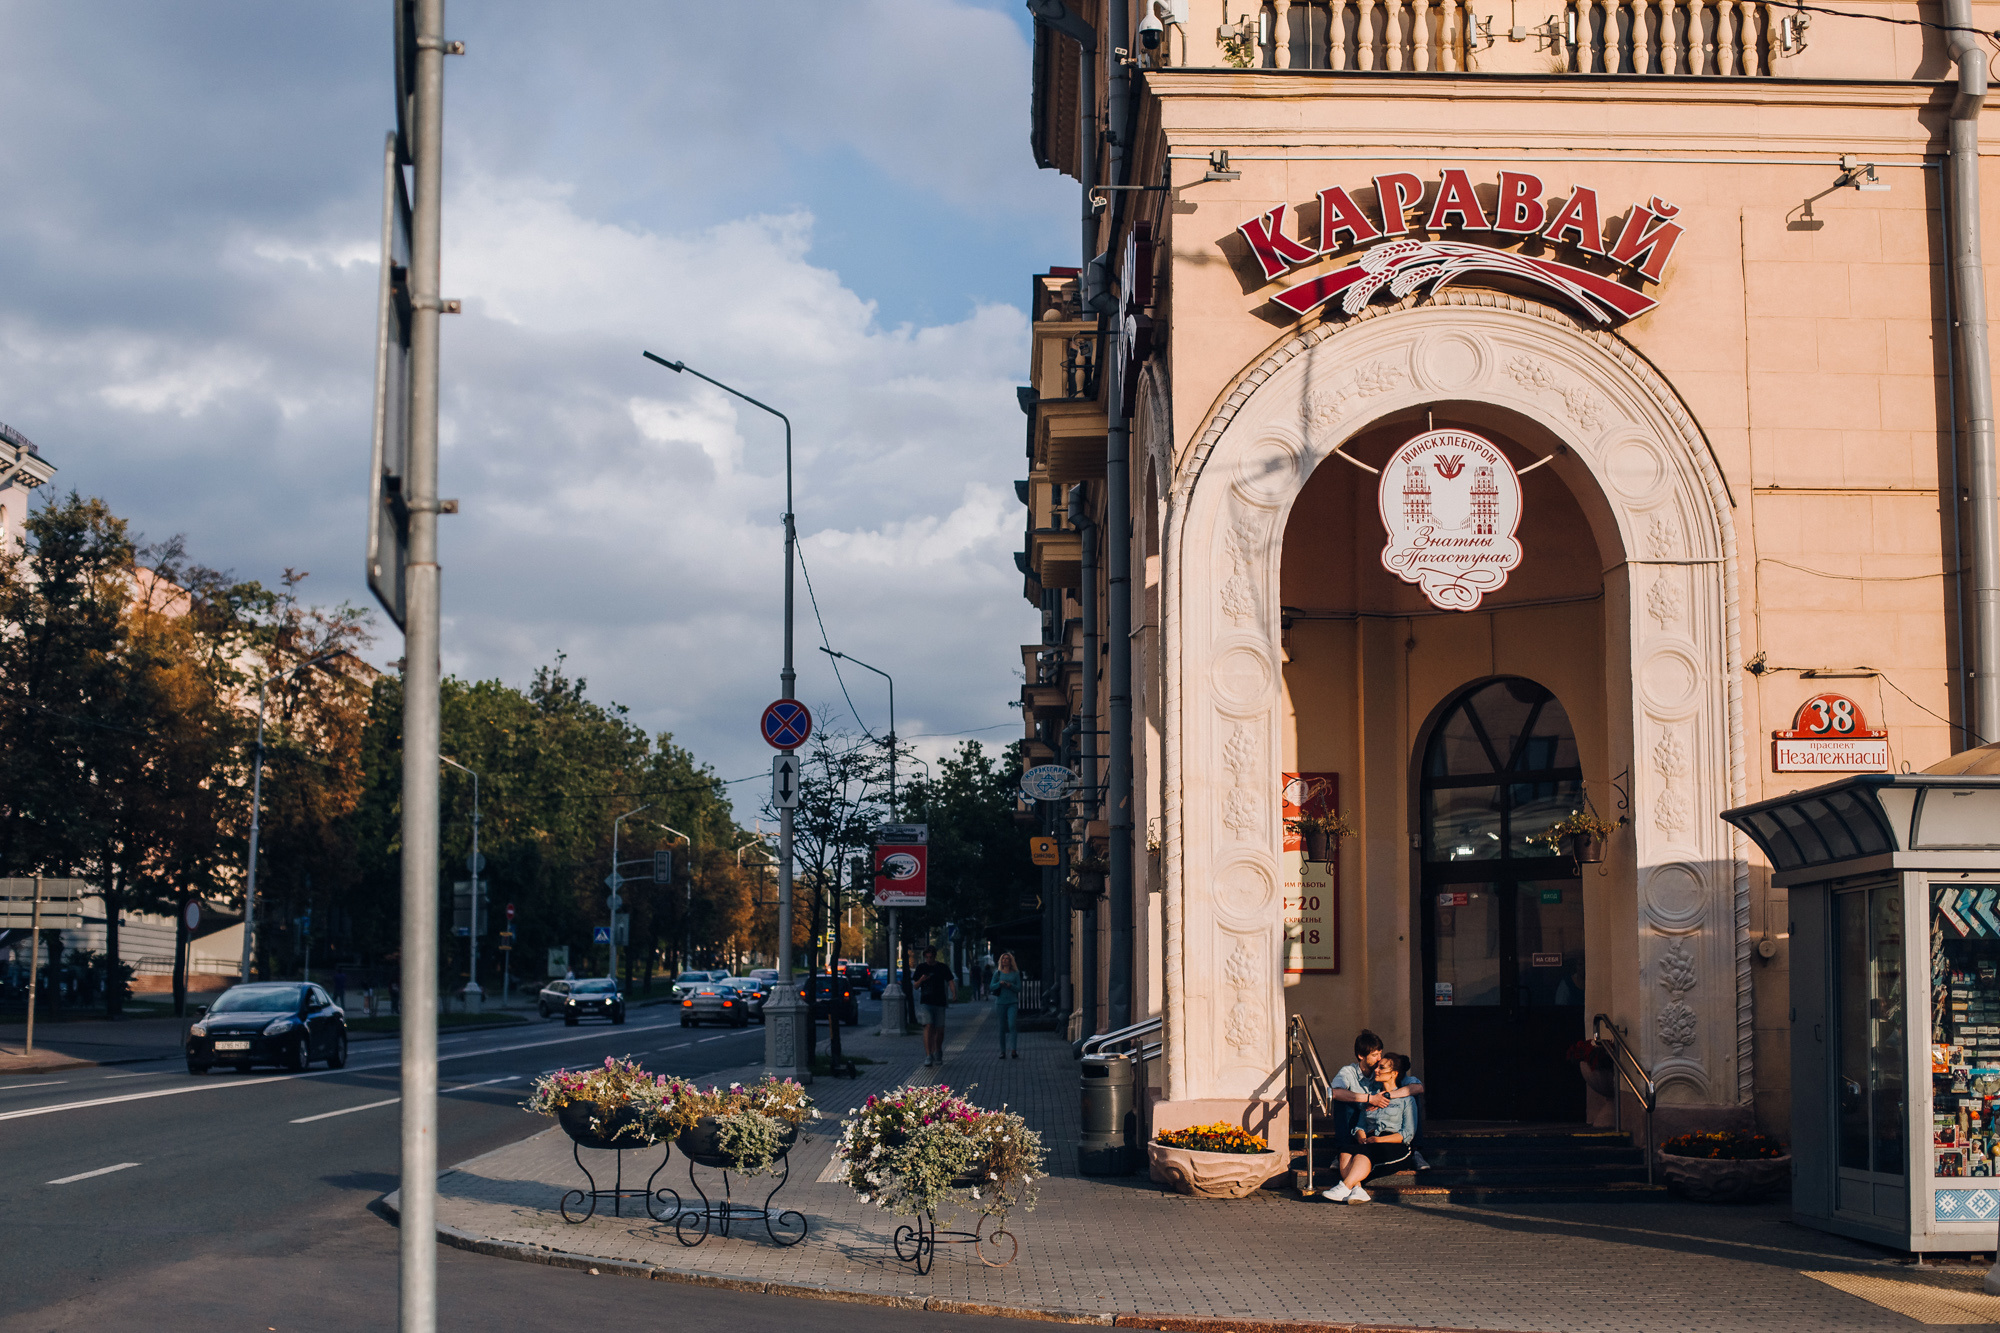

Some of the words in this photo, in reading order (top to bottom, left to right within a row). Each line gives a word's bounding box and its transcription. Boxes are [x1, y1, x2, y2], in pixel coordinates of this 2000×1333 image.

[1237, 168, 1686, 284] КАРАВАЙ
[1400, 436, 1498, 465] МИНСКХЛЕБПРОМ
[1413, 526, 1495, 547] Знатны
[1810, 699, 1855, 734] 38
[1780, 748, 1886, 767] Незалежнасці
[1810, 742, 1855, 751] праспект
